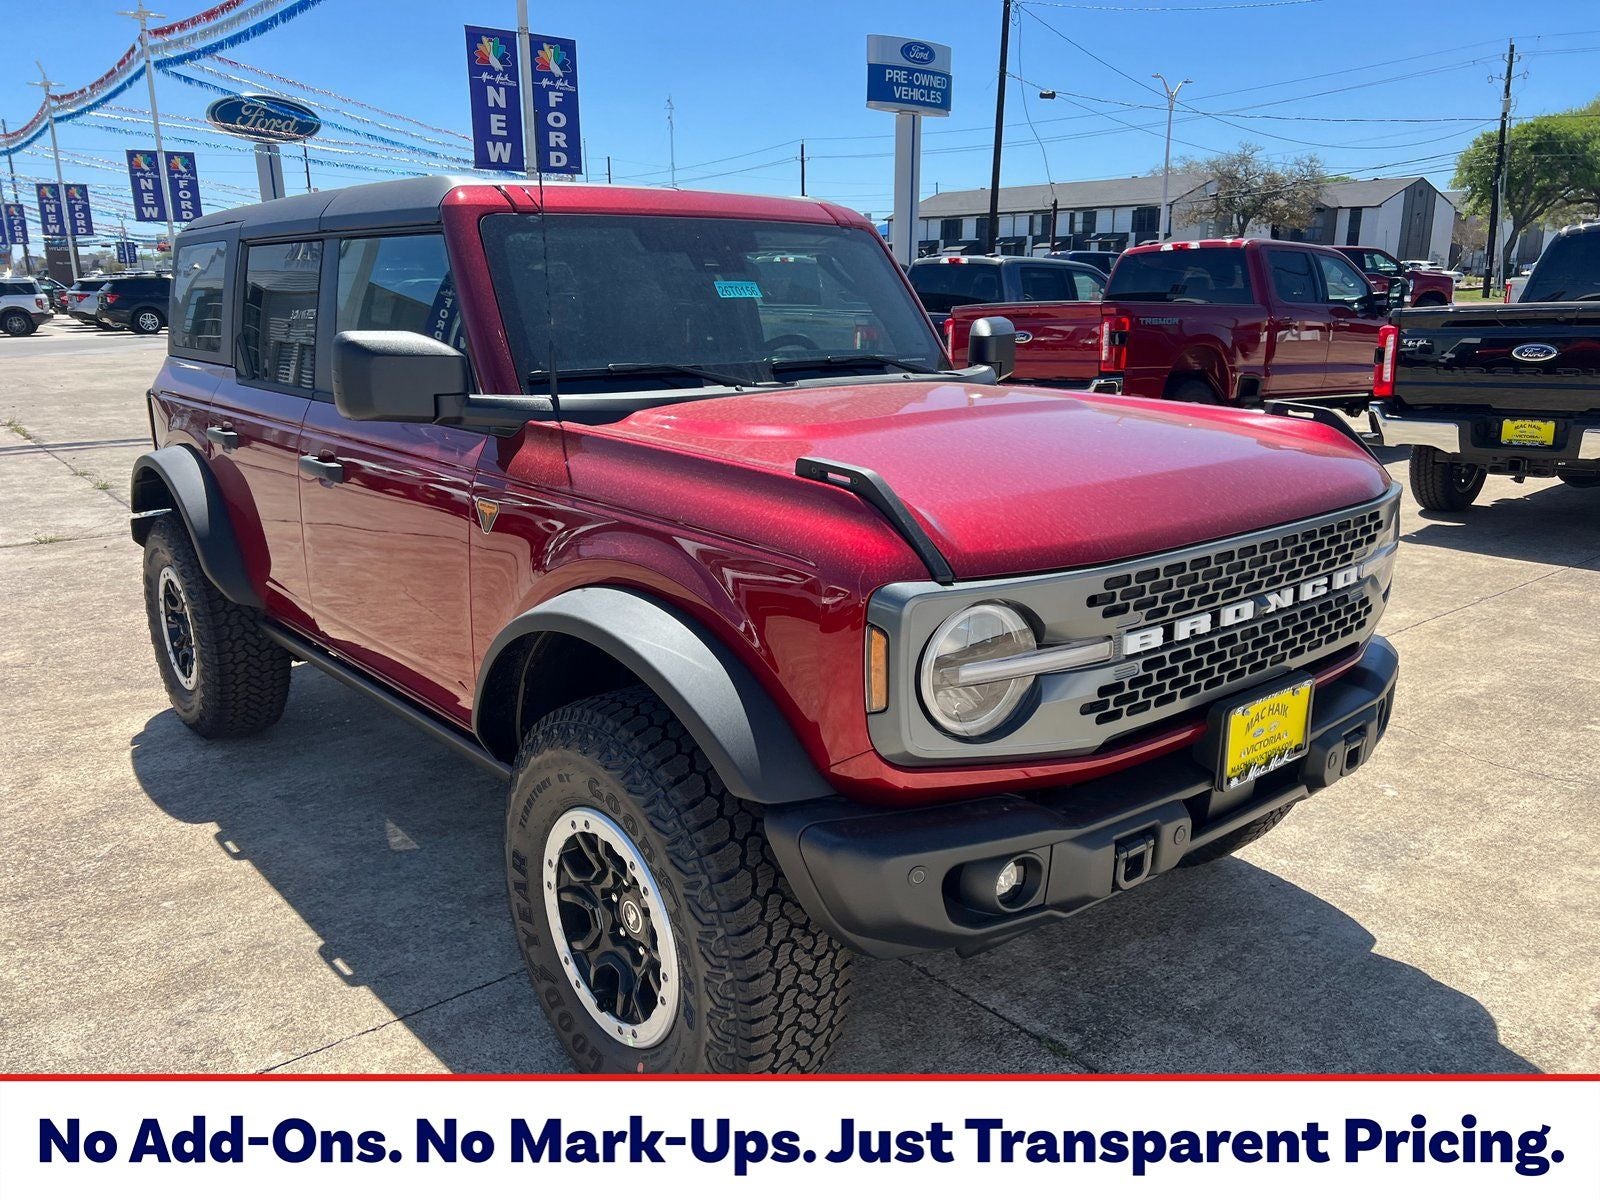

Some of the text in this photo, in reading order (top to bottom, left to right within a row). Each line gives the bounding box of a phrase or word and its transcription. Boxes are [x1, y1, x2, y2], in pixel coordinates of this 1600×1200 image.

[909, 44, 930, 60] Ford
[893, 86, 942, 104] VEHICLES
[235, 102, 299, 133] Ford
[486, 85, 512, 164] NEW
[546, 91, 568, 167] FORD
[140, 178, 159, 219] NEW
[178, 179, 194, 220] FORD
[13, 219, 24, 243] FORD
[46, 203, 60, 234] NEW
[74, 204, 87, 234] FORD
[1139, 317, 1179, 325] TREMOR
[1521, 347, 1546, 358] Ford
[1123, 566, 1359, 656] BRONCO
[1245, 707, 1266, 735] MAC
[1267, 702, 1289, 718] HAIK
[1246, 732, 1282, 756] VICTORIA
[1247, 749, 1290, 781] Mac Haik
